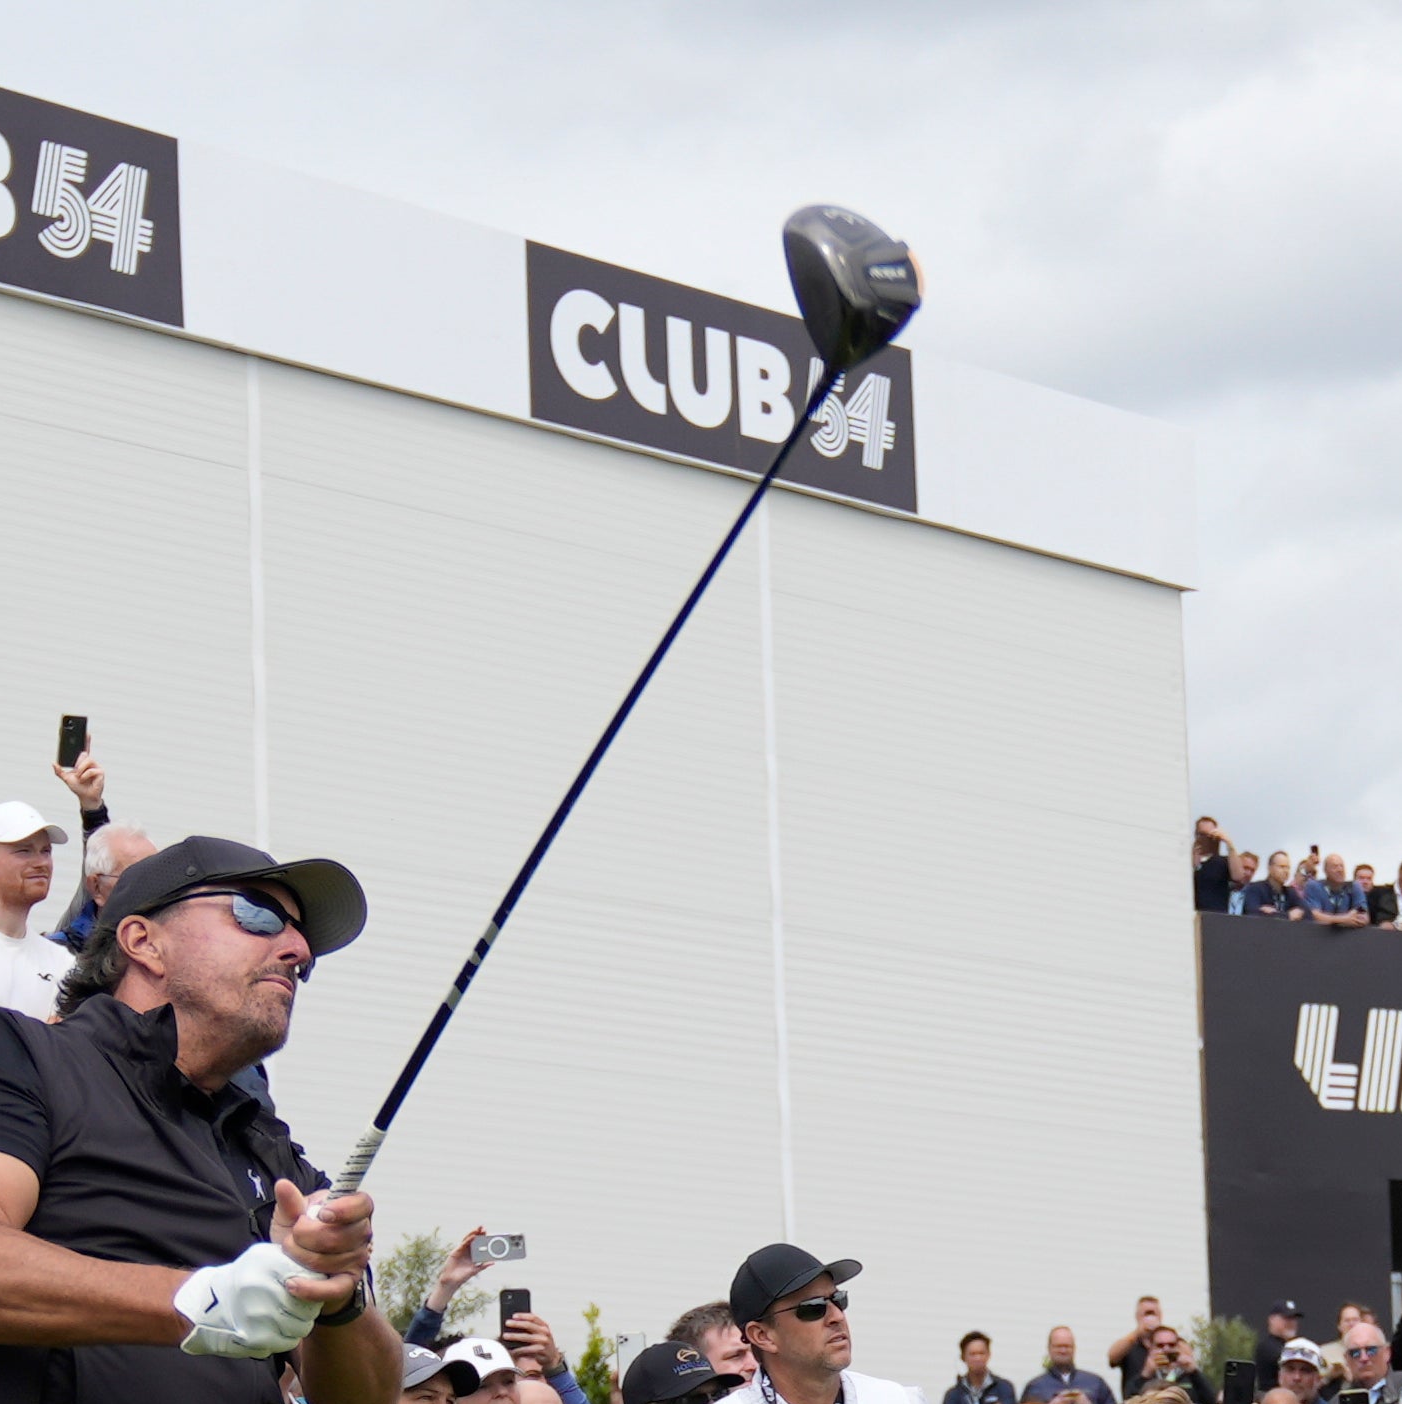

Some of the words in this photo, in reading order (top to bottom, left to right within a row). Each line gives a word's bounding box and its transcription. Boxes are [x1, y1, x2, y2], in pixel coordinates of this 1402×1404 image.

[31, 140, 154, 276] 54
[549, 288, 796, 444] CLUB
[808, 356, 895, 472] 54
